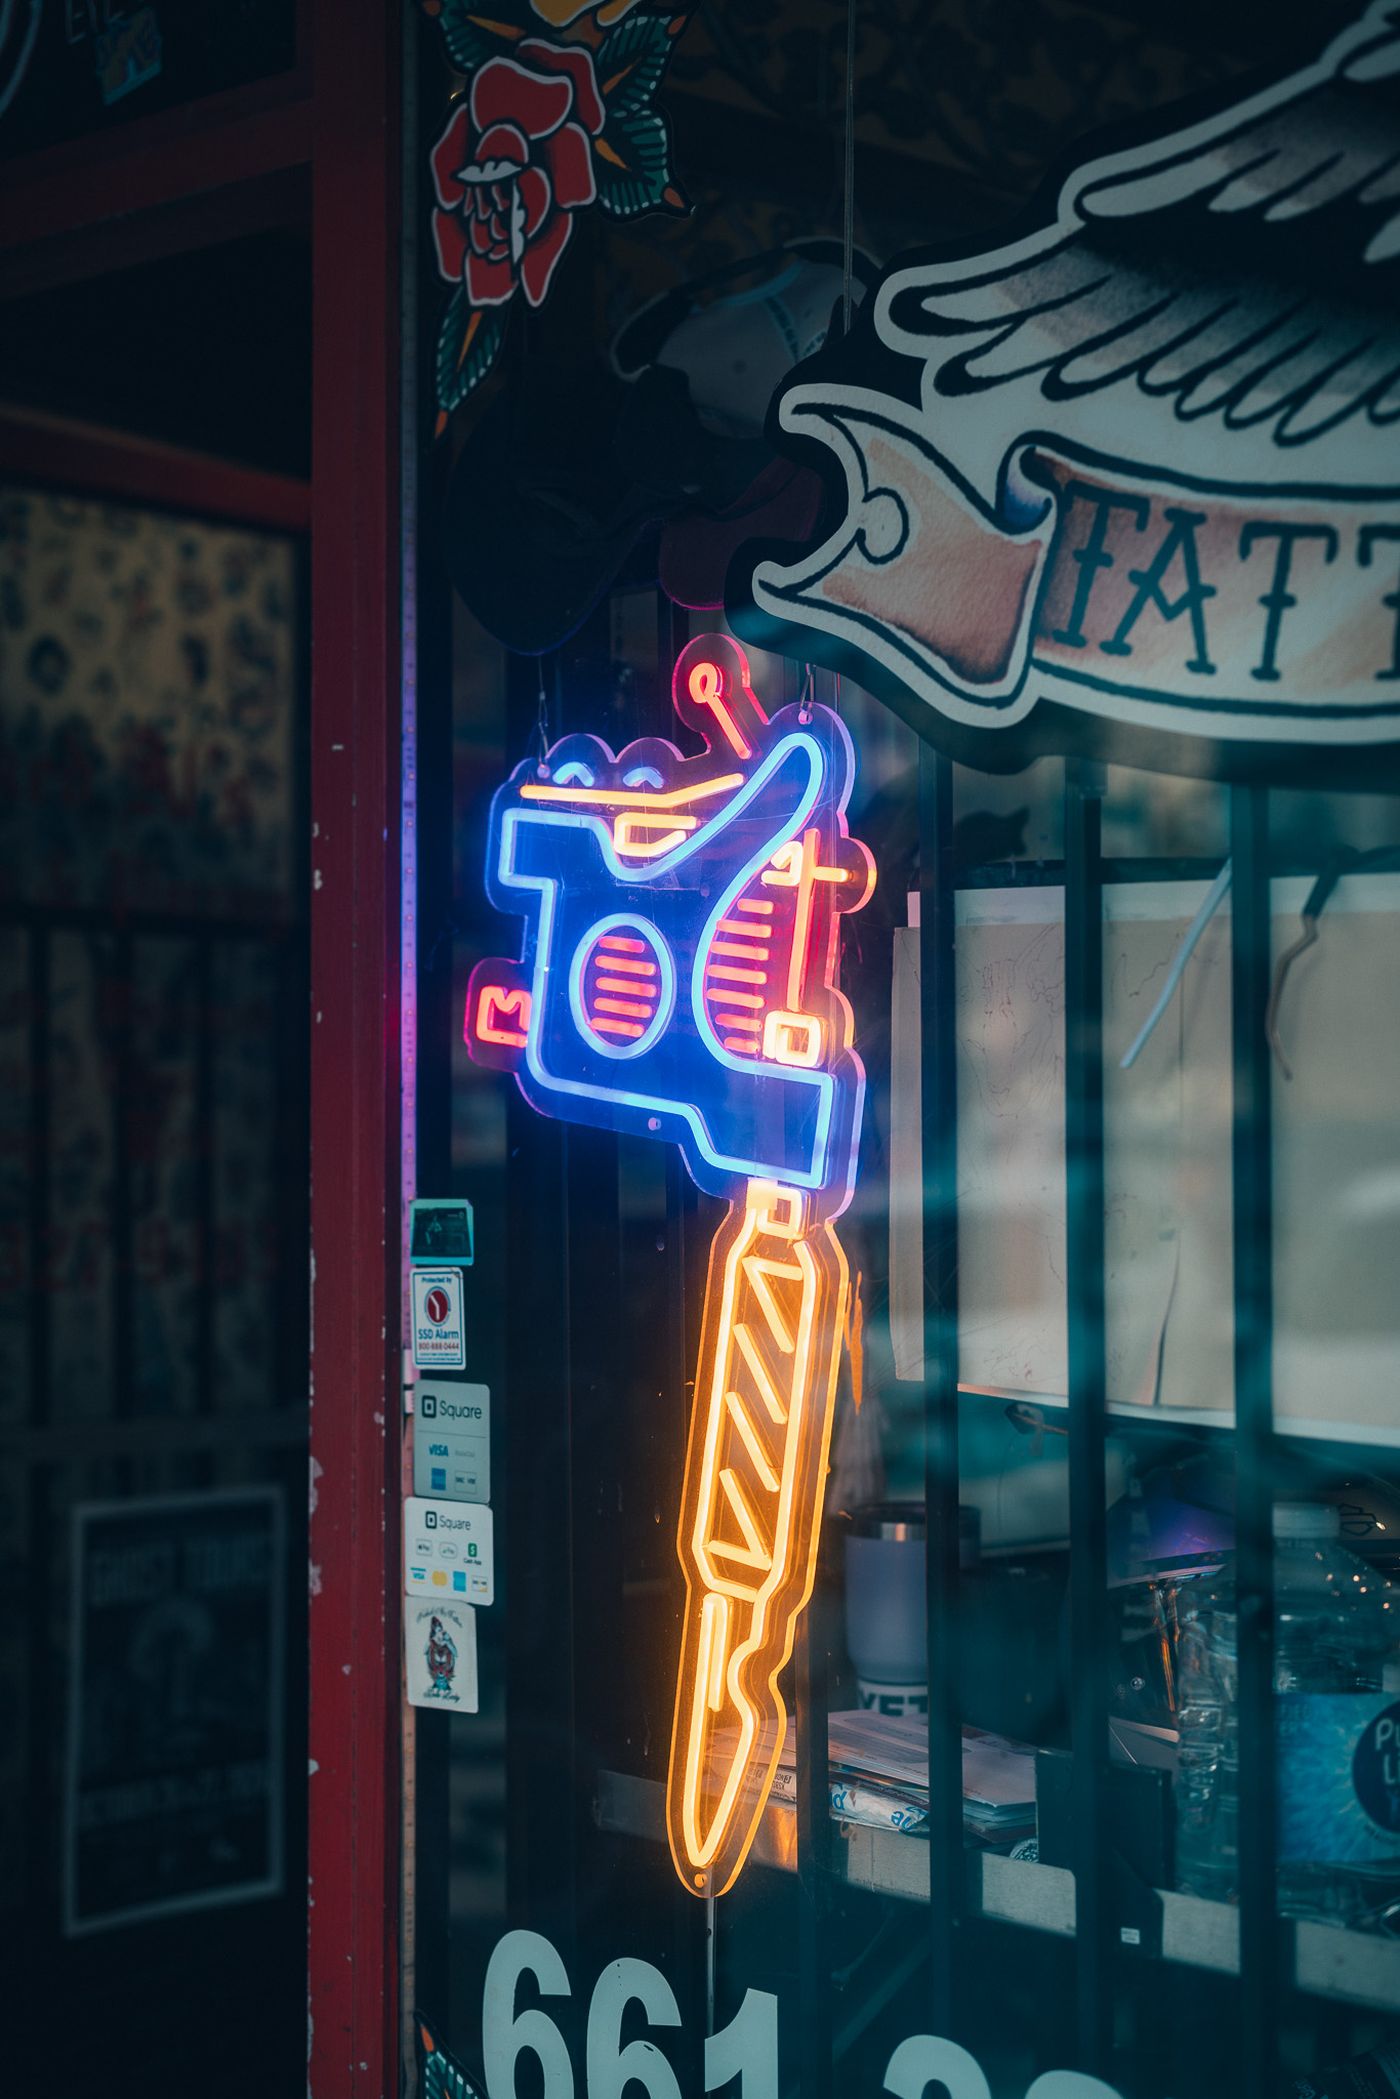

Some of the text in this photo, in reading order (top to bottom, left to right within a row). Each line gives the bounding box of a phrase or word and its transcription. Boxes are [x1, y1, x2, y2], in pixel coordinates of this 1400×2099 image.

[418, 1328, 459, 1339] SSD Alarm
[439, 1400, 482, 1420] Square
[428, 1444, 449, 1457] VISA
[439, 1514, 471, 1531] Square
